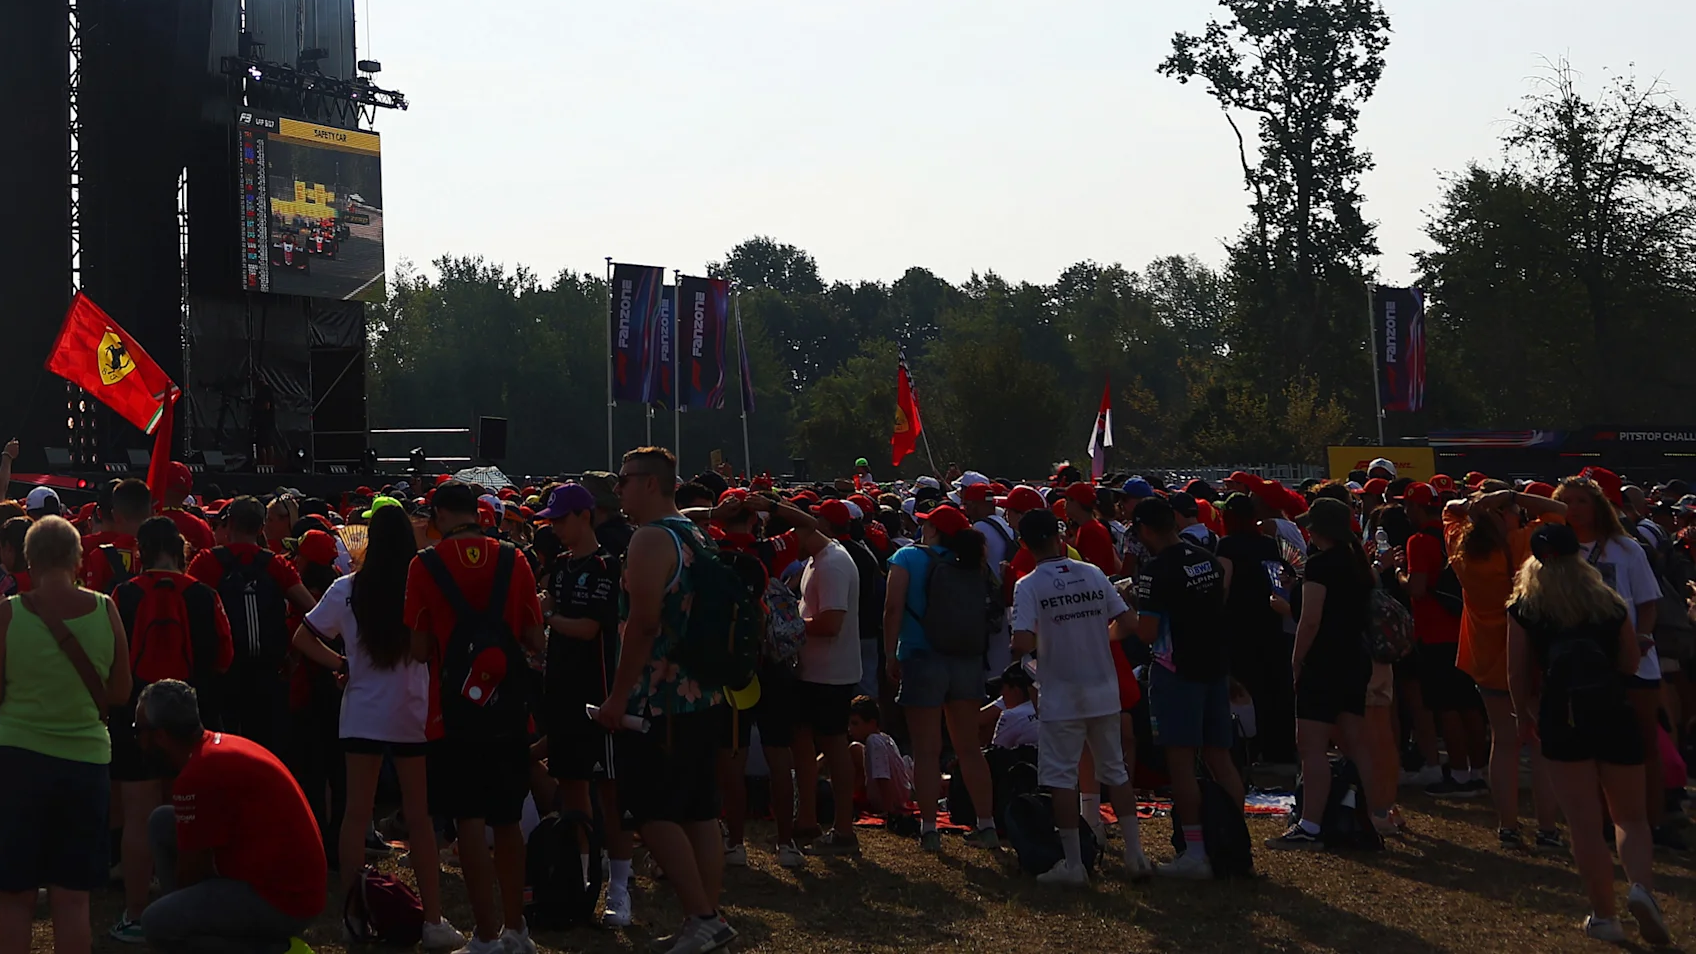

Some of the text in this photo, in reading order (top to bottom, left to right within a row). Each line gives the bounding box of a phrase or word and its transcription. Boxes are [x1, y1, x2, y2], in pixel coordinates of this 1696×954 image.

[314, 129, 347, 143] SAFETY CAR
[1619, 431, 1661, 442] PITSTOP
[1185, 571, 1220, 588] ALPINE
[1040, 589, 1105, 610] PETRONAS
[1054, 608, 1102, 623] CROWDSTRIK
